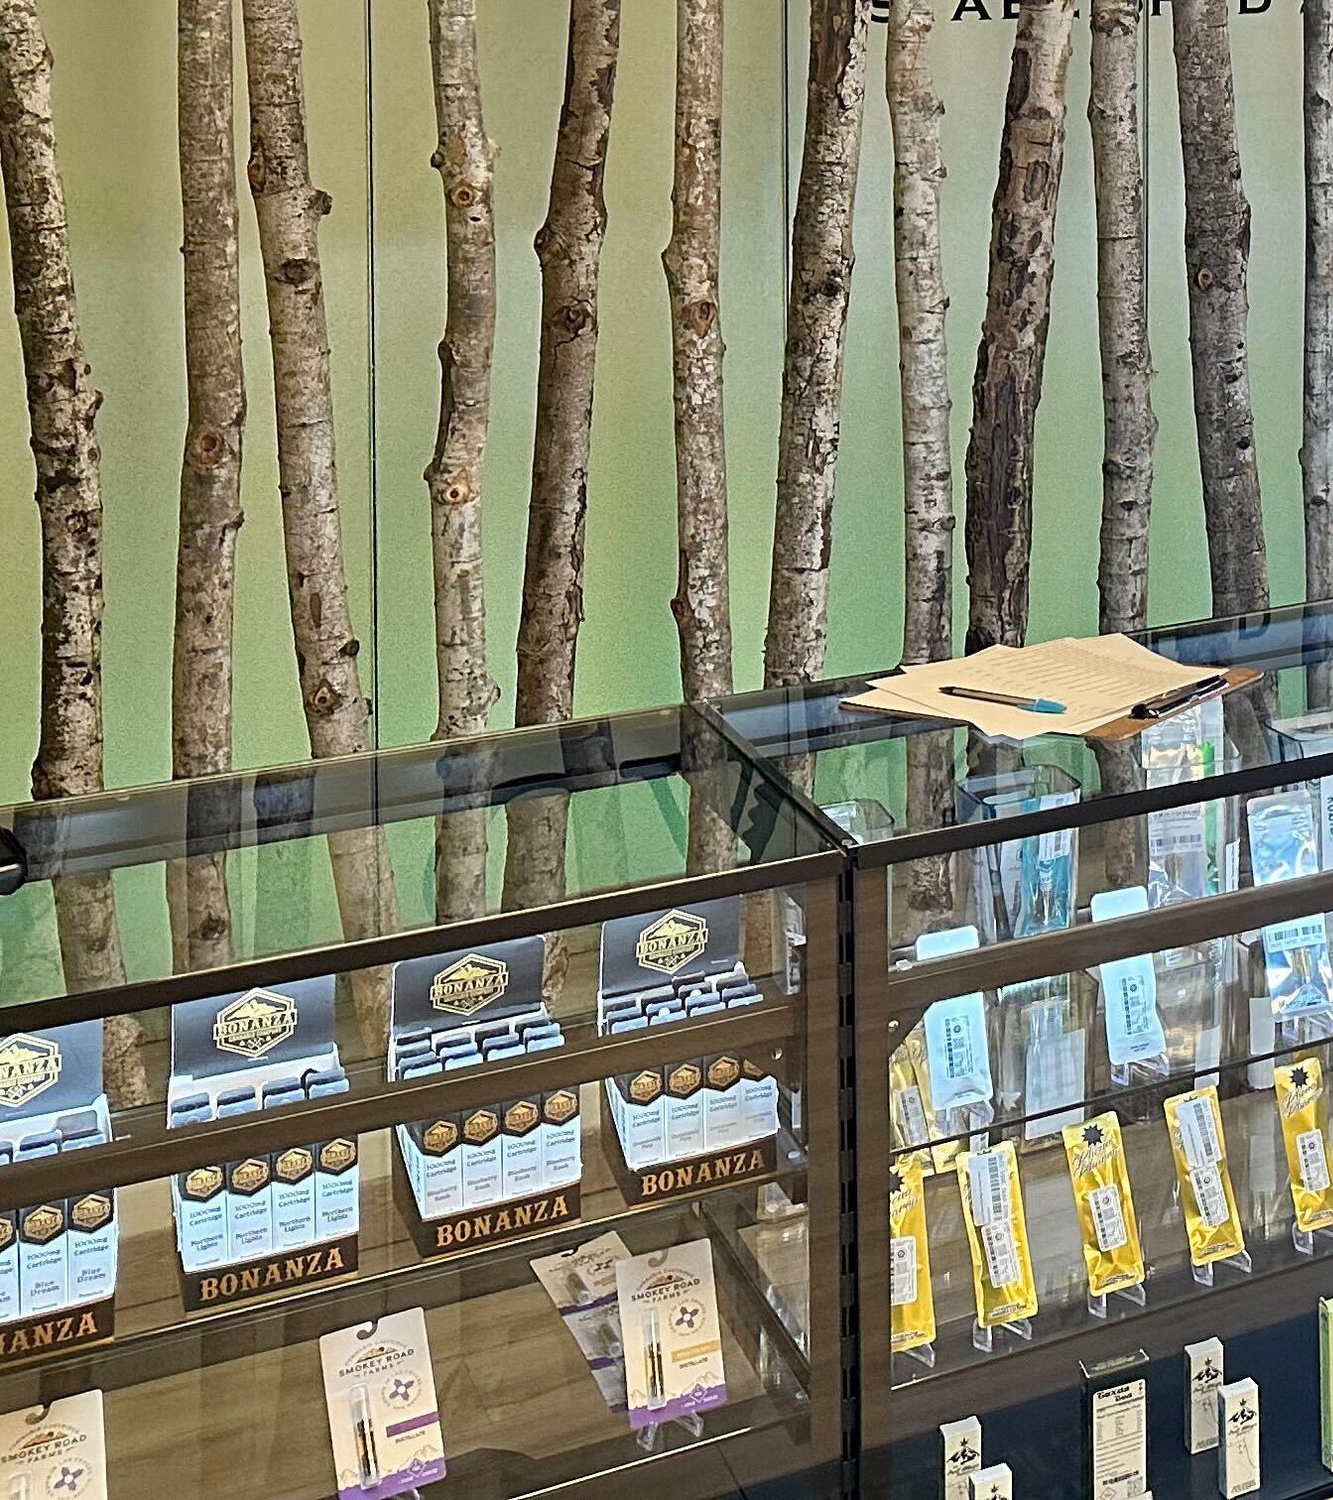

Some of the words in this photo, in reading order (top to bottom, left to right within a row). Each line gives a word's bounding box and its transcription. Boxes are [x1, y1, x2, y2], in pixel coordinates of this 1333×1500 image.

[640, 930, 706, 951] BONANZA
[435, 974, 507, 996] BONANZA
[217, 1012, 295, 1035] BONANZA
[642, 1149, 766, 1196] BONANZA
[436, 1195, 569, 1247] BONANZA
[200, 1247, 345, 1301] BONANZA
[631, 1286, 671, 1302] SMOKEY
[673, 1277, 701, 1292] ROAD
[652, 1291, 681, 1303] FARMS
[338, 1358, 383, 1377] SMOKEY
[386, 1348, 415, 1363] ROAD
[362, 1365, 395, 1378] FARMS
[0, 1444, 50, 1463] SMOKEY
[54, 1434, 87, 1449] ROAD
[27, 1449, 63, 1463] FARMS
